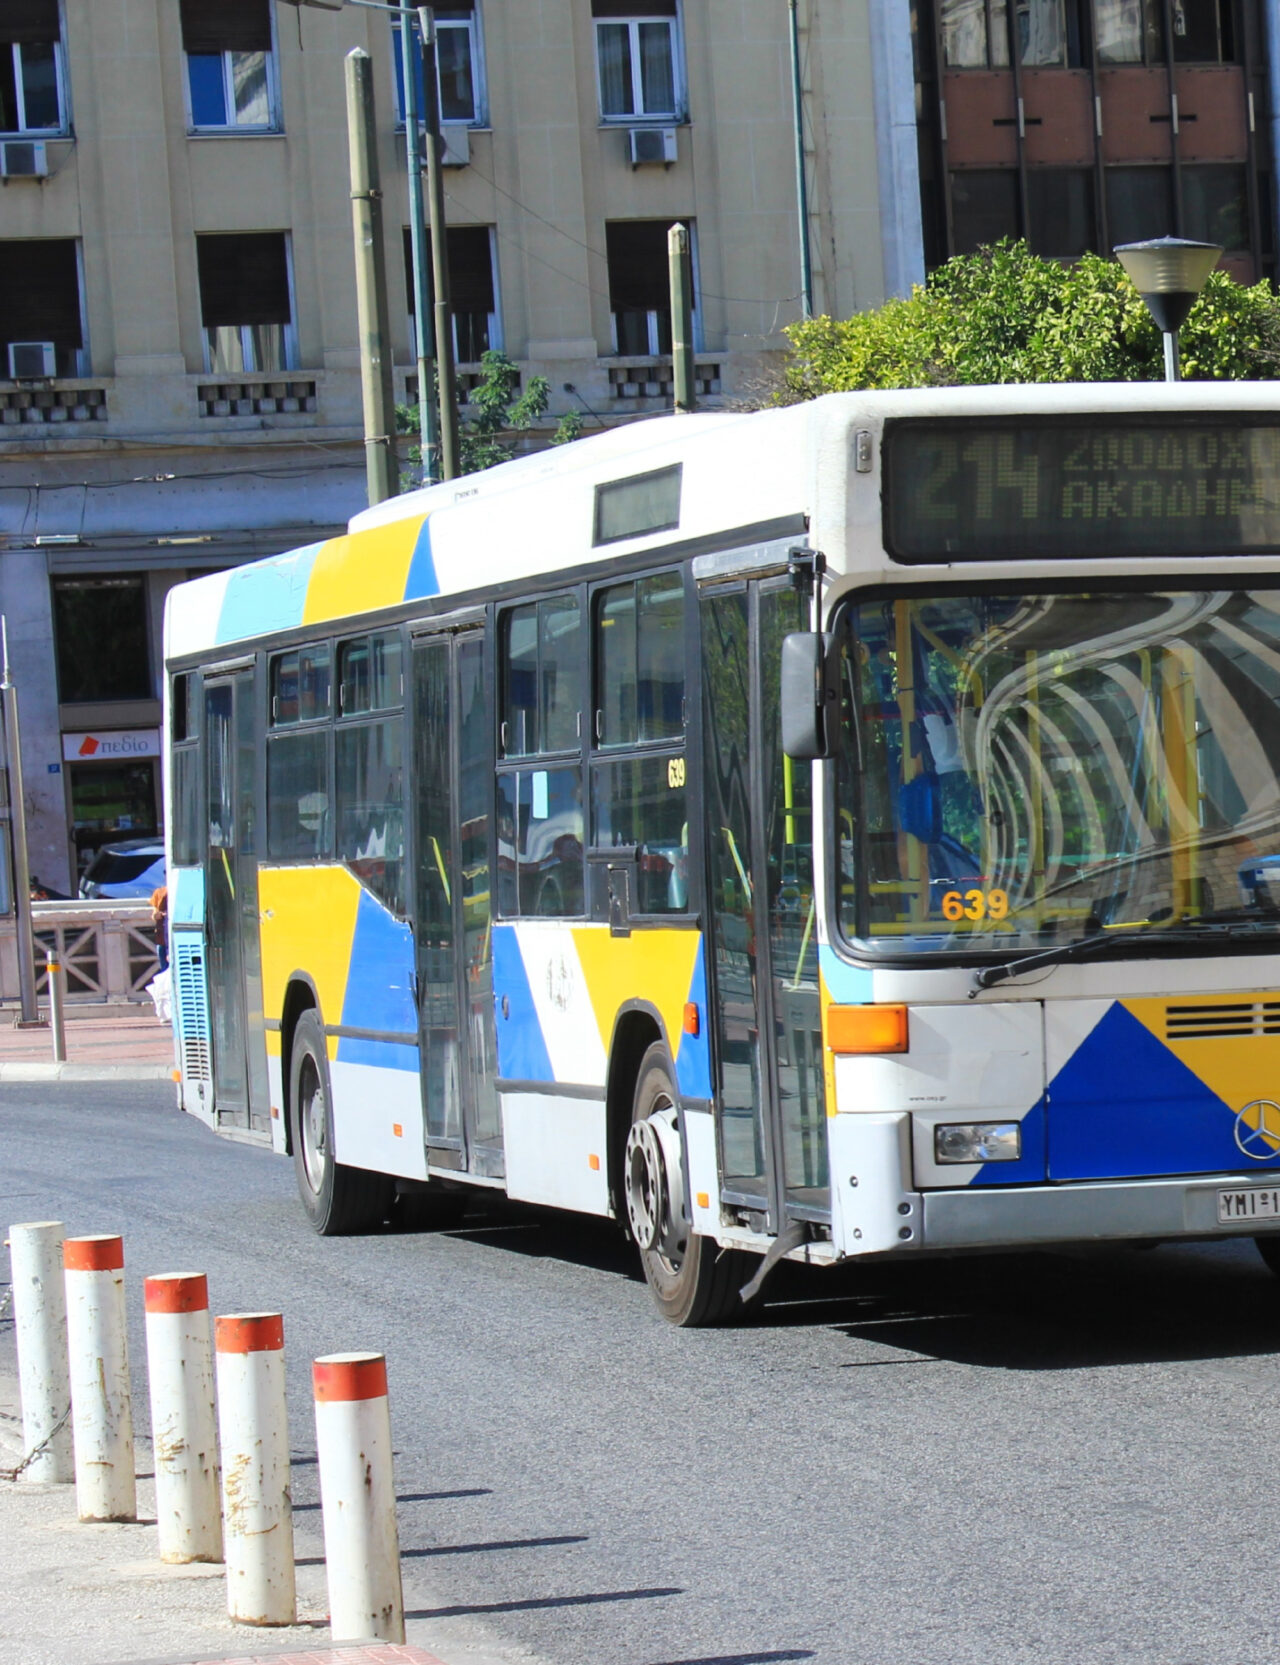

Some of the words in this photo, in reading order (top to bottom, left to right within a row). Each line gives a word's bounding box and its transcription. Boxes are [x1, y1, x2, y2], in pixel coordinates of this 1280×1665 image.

[914, 433, 1039, 519] 214
[101, 735, 148, 753] πεδίο
[668, 758, 685, 788] 639
[942, 888, 1009, 921] 639
